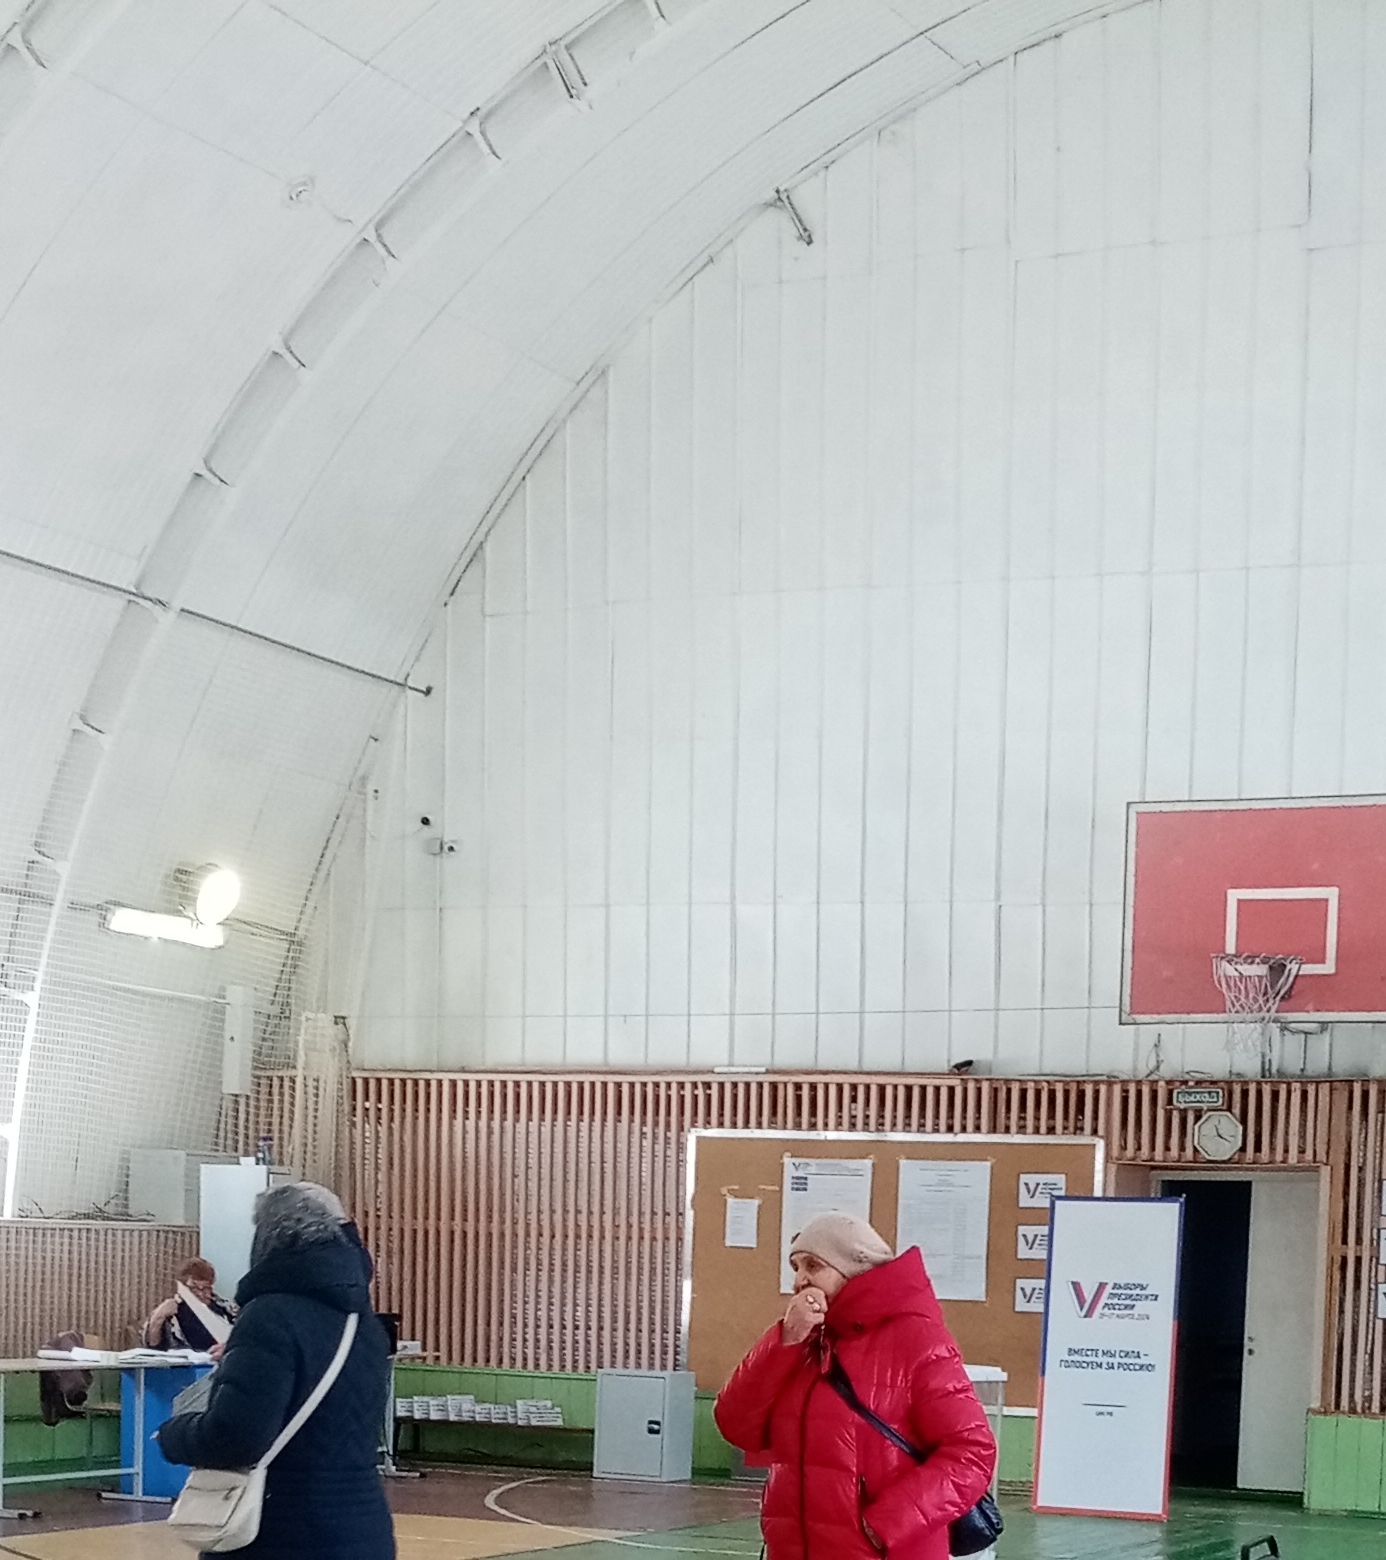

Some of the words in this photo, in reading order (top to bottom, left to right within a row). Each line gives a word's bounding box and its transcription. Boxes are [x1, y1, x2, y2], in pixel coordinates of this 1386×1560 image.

[1067, 1347, 1100, 1358] ВМЕСТЕ
[1101, 1349, 1116, 1359] МЫ
[1118, 1349, 1141, 1359] СИЛА
[1059, 1359, 1103, 1370] ГОЛОСУЕМ
[1104, 1361, 1115, 1371] ЗА
